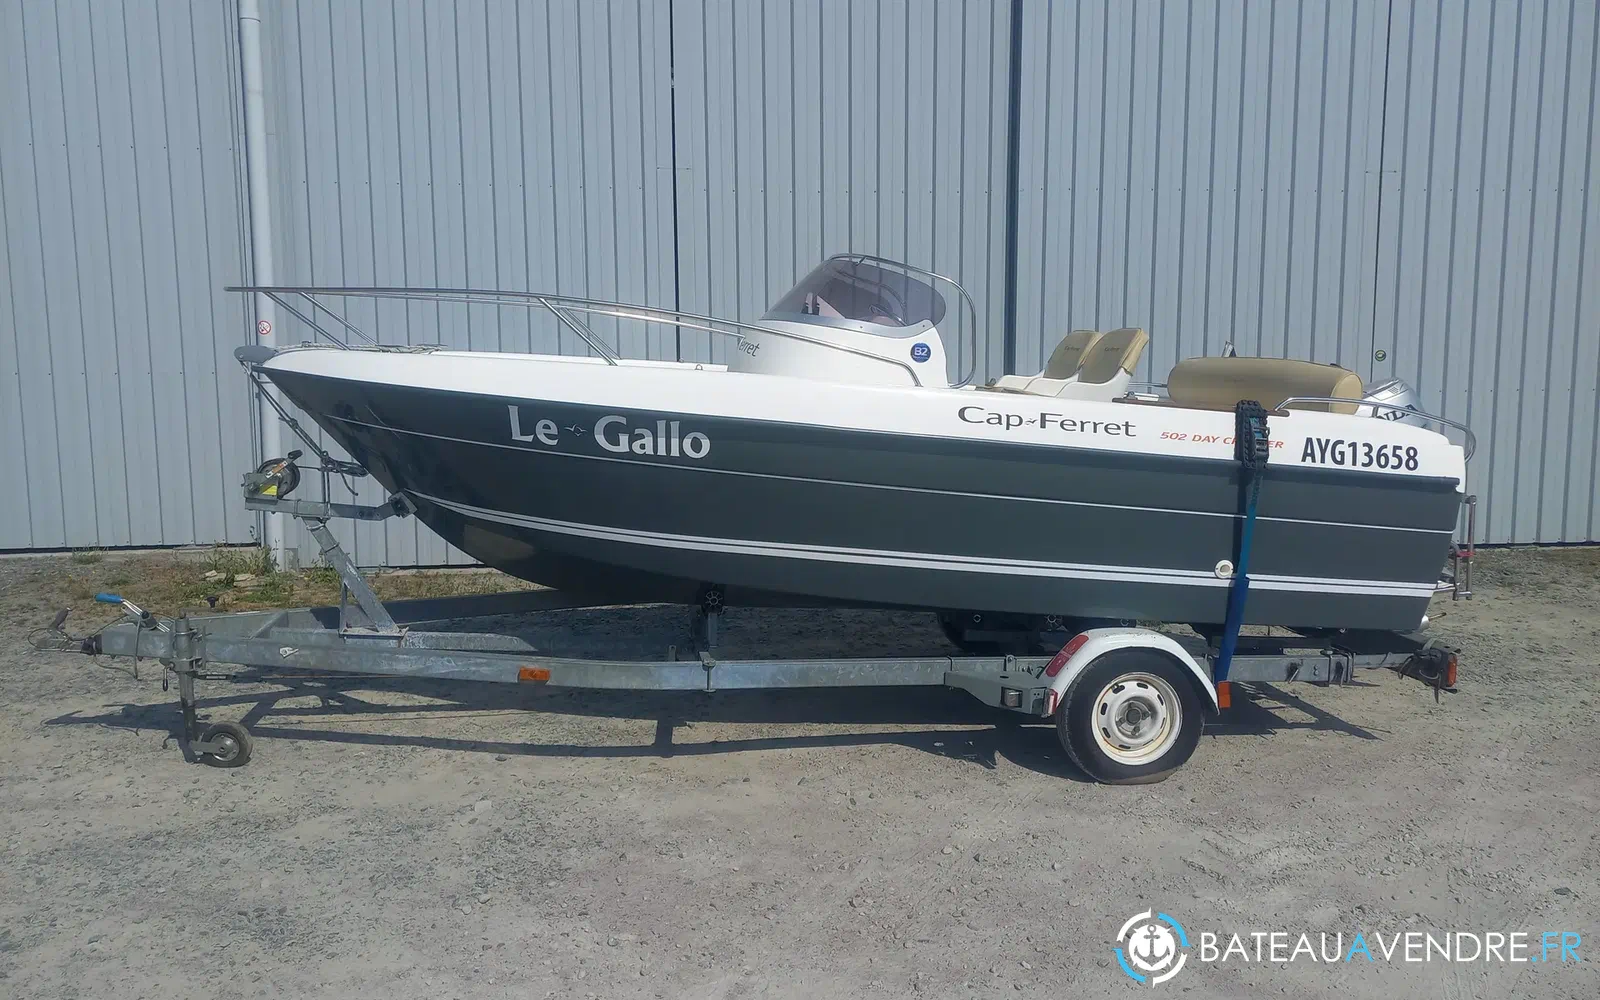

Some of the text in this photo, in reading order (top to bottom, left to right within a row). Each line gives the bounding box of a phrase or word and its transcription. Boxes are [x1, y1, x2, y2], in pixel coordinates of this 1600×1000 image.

[914, 347, 928, 356] B2
[508, 405, 711, 459] Le Gallo
[958, 406, 1137, 437] Cap Ferret
[1160, 431, 1187, 441] 502
[1191, 434, 1220, 443] DAY
[1301, 437, 1419, 471] AYG13658
